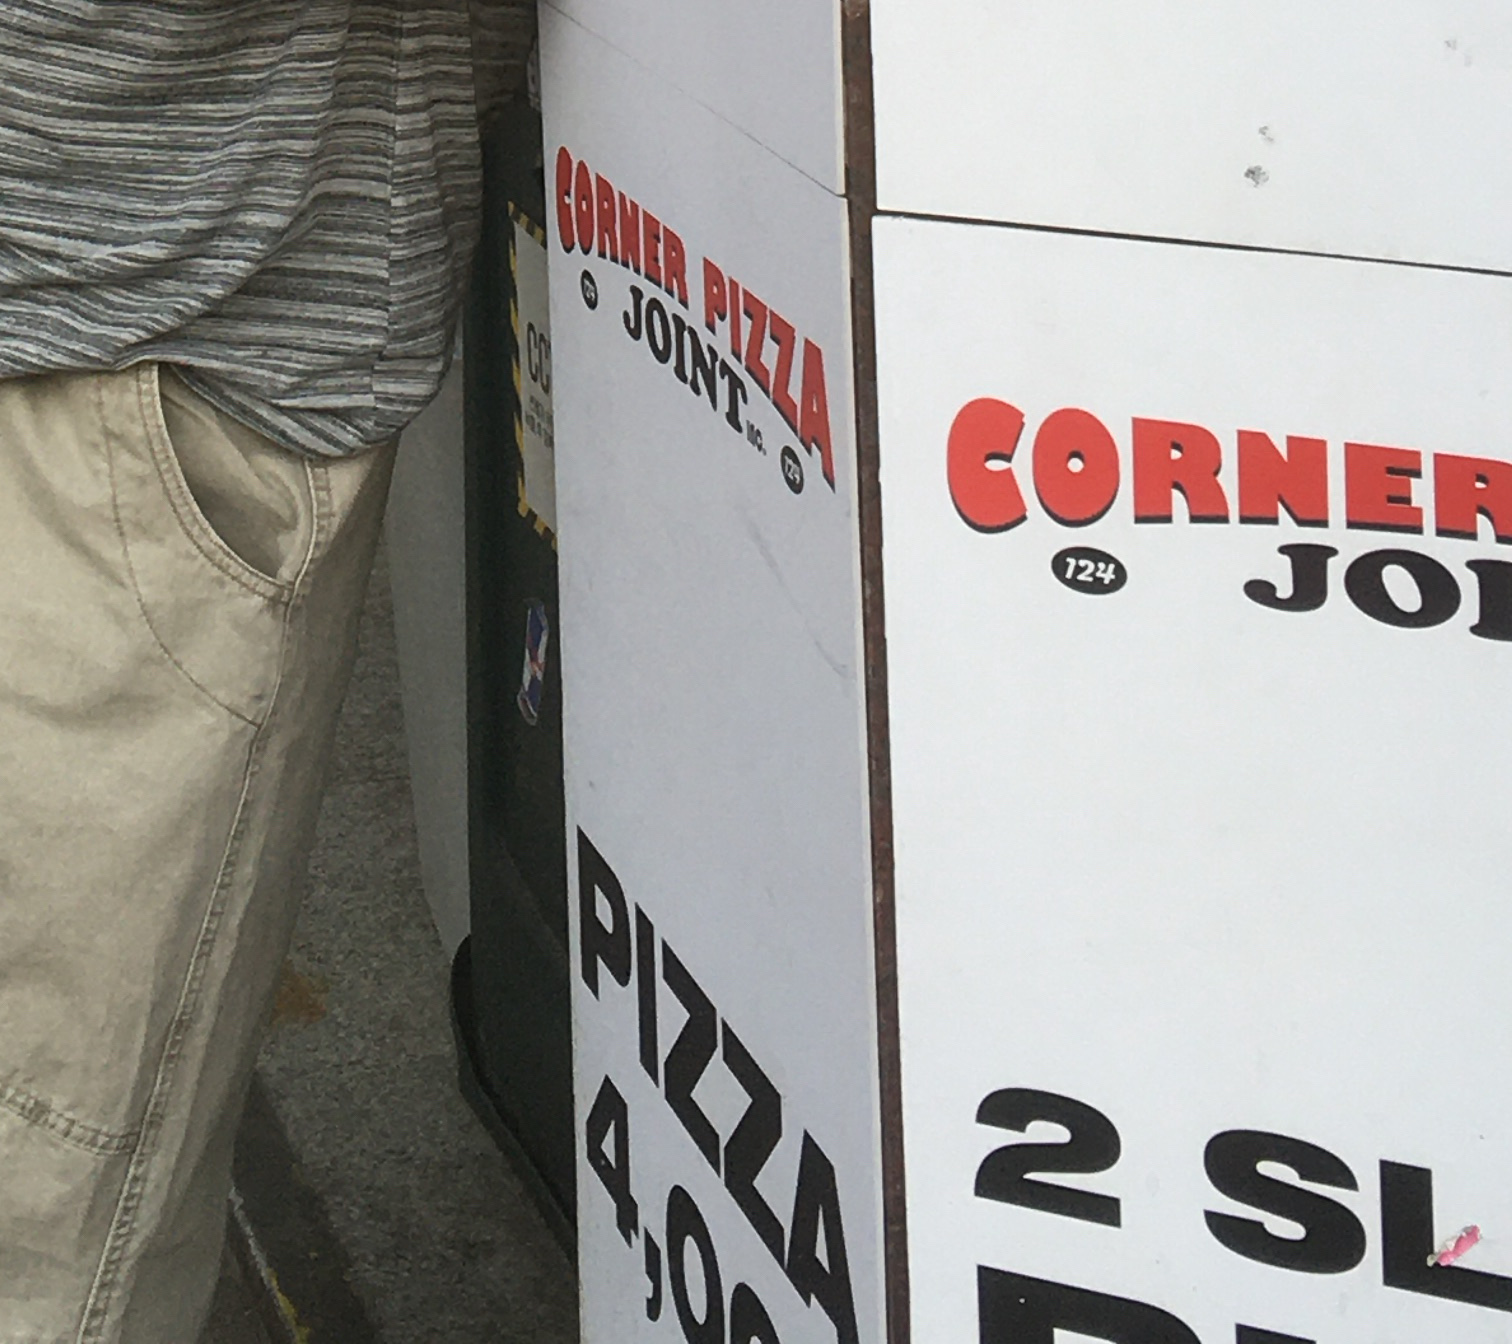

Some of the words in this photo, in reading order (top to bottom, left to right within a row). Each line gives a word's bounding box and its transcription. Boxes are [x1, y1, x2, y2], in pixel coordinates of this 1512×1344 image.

[526, 321, 552, 396] CC
[556, 146, 689, 310] CORNER
[703, 256, 836, 493] PIZZA
[623, 285, 748, 433] JOINT
[946, 397, 1512, 546] CORNER
[1063, 556, 1117, 584] 124
[577, 825, 859, 1344] PIZZA
[975, 1087, 1122, 1229] 2
[1203, 1129, 1512, 1313] SL
